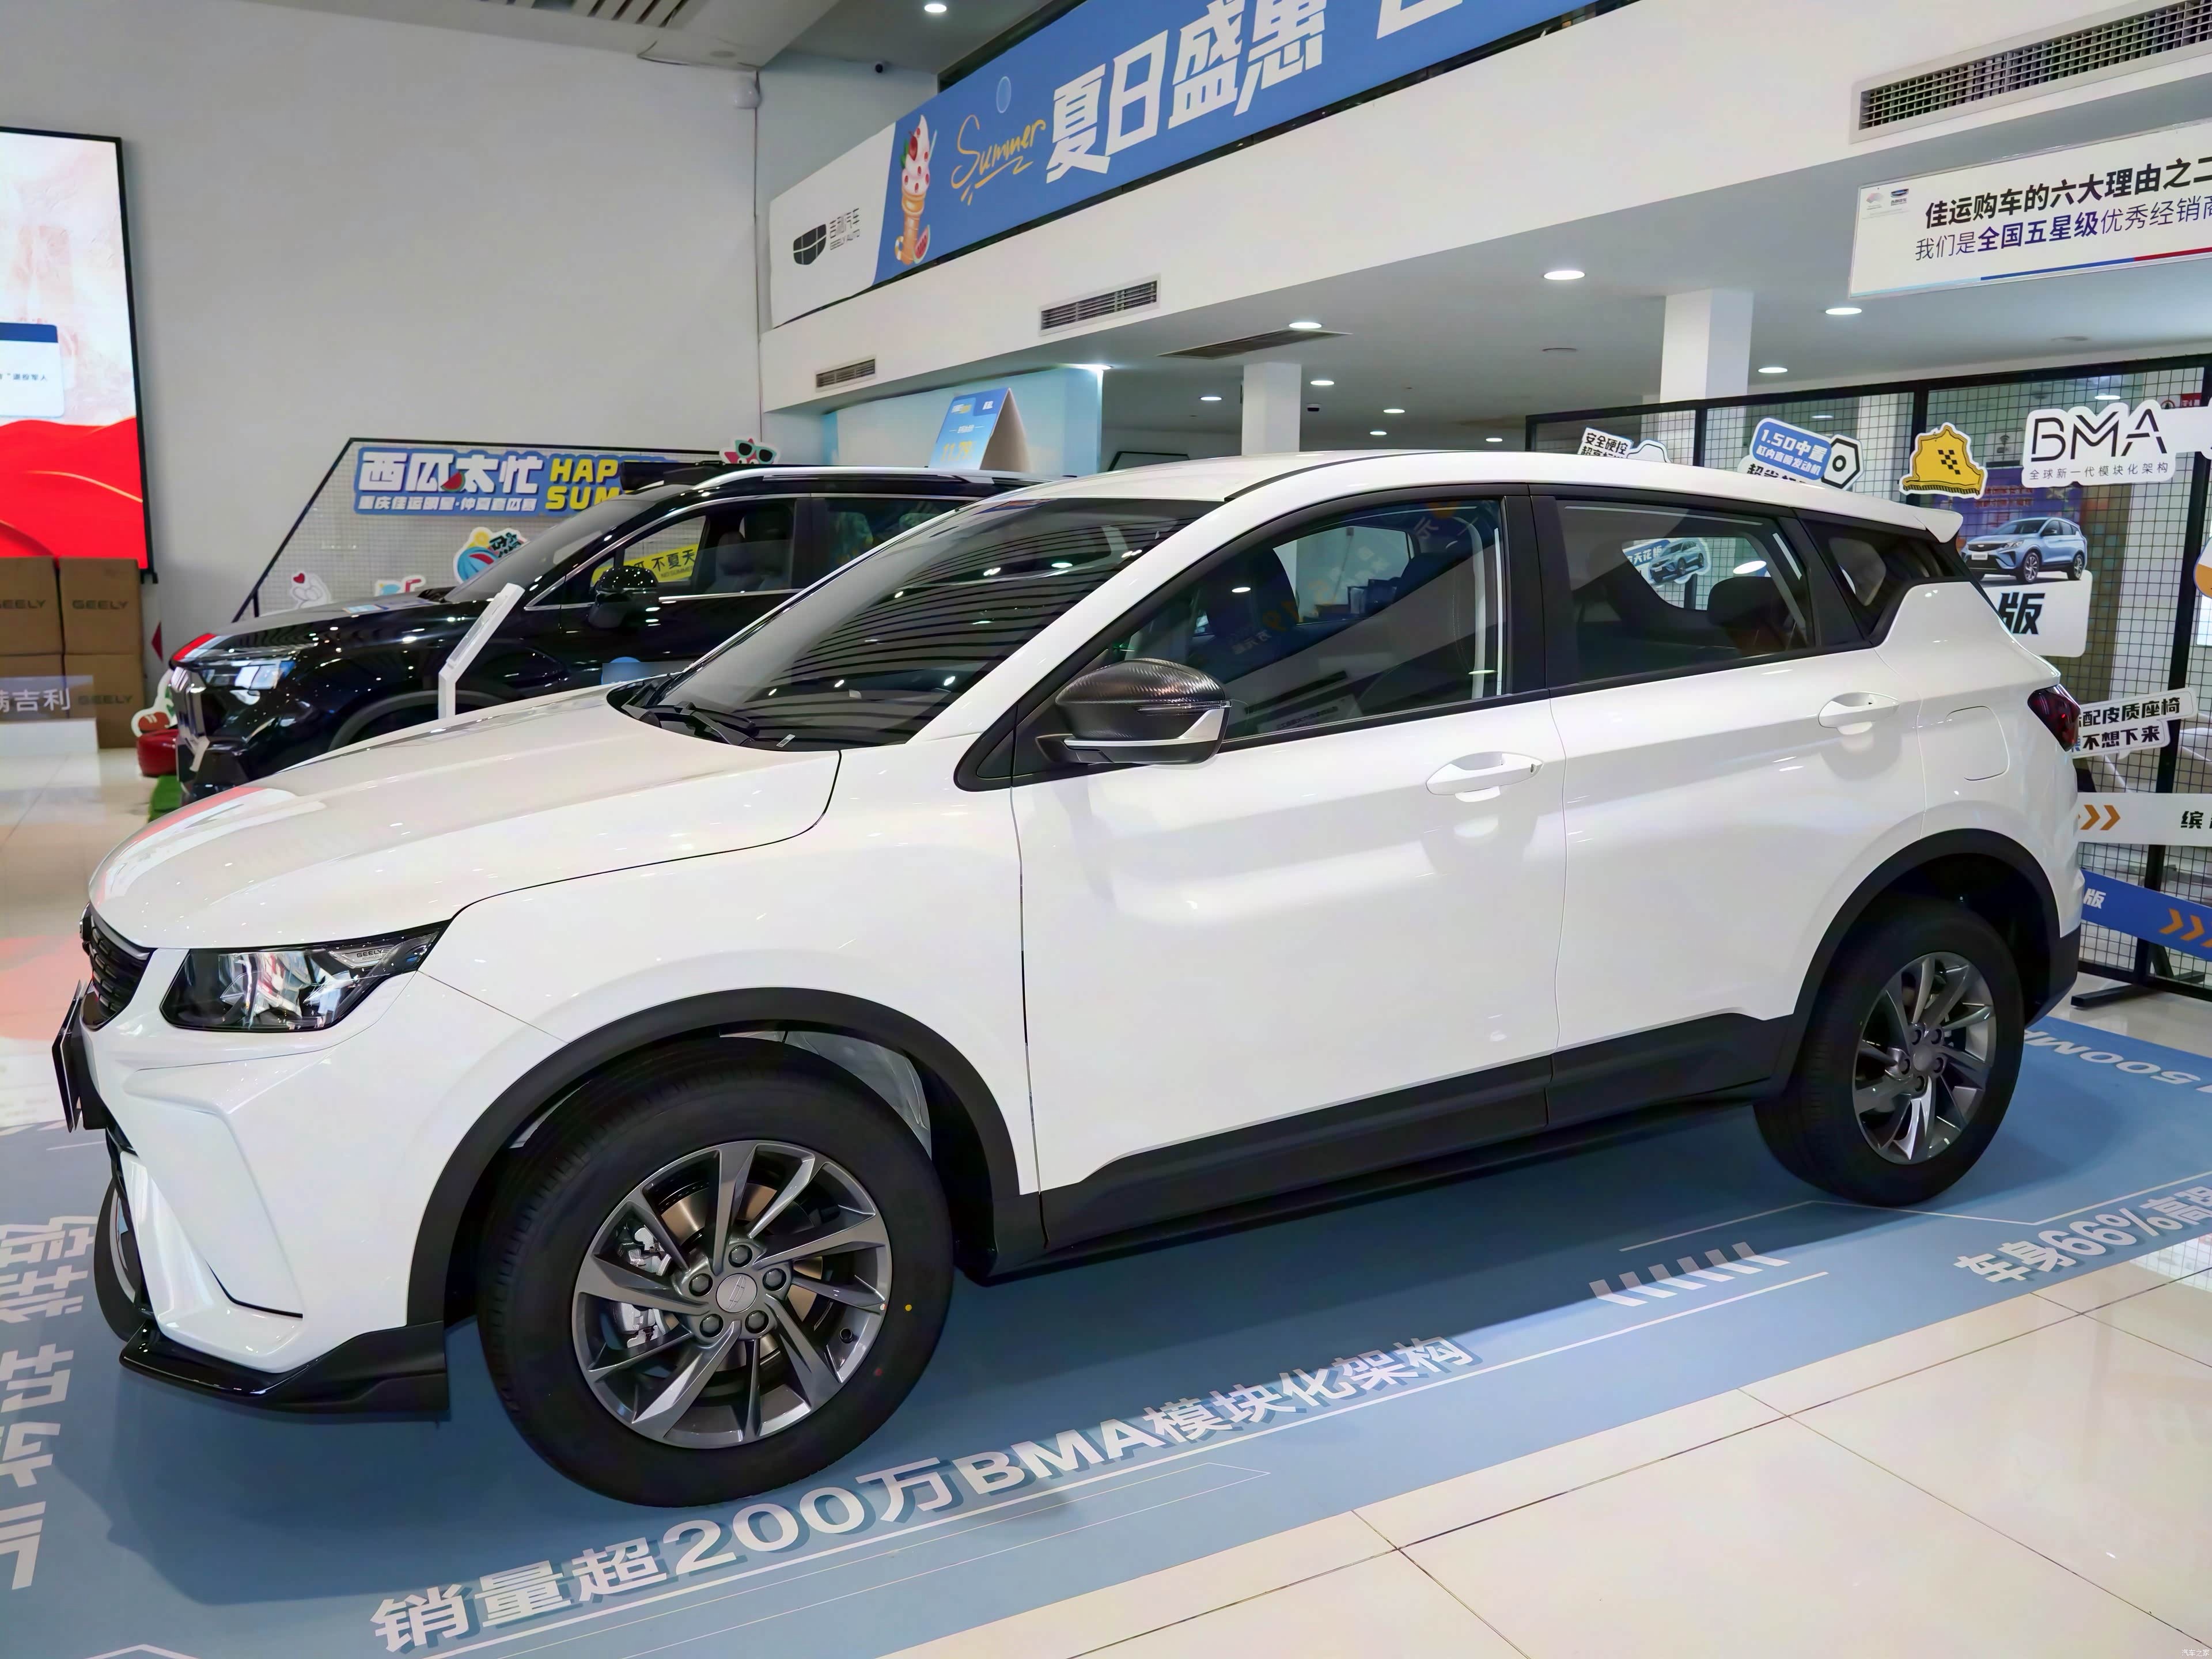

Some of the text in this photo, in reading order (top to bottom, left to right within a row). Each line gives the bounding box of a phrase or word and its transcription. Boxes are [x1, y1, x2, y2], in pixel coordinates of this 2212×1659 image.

[1046, 0, 1325, 183] 夏日盛惠
[951, 115, 1046, 190] Summer
[1925, 156, 2212, 229] 佳运购车的六大理由之二
[1585, 432, 1628, 455] 安全硬控
[2031, 408, 2168, 463] BMA
[358, 452, 544, 494] 西瓜太忙
[550, 458, 619, 483] HAP
[2029, 461, 2168, 480] 全球新一代模块化架构
[0, 599, 46, 609] EELY
[72, 600, 128, 610] GEELY
[1998, 592, 2046, 635] 版
[2078, 697, 2180, 728] 配皮质座椅
[2180, 810, 2212, 829] 缤
[2083, 888, 2107, 909] 版
[357, 949, 384, 958] GEELY
[370, 1335, 1474, 1653] 销量超200万BMA模块化架构
